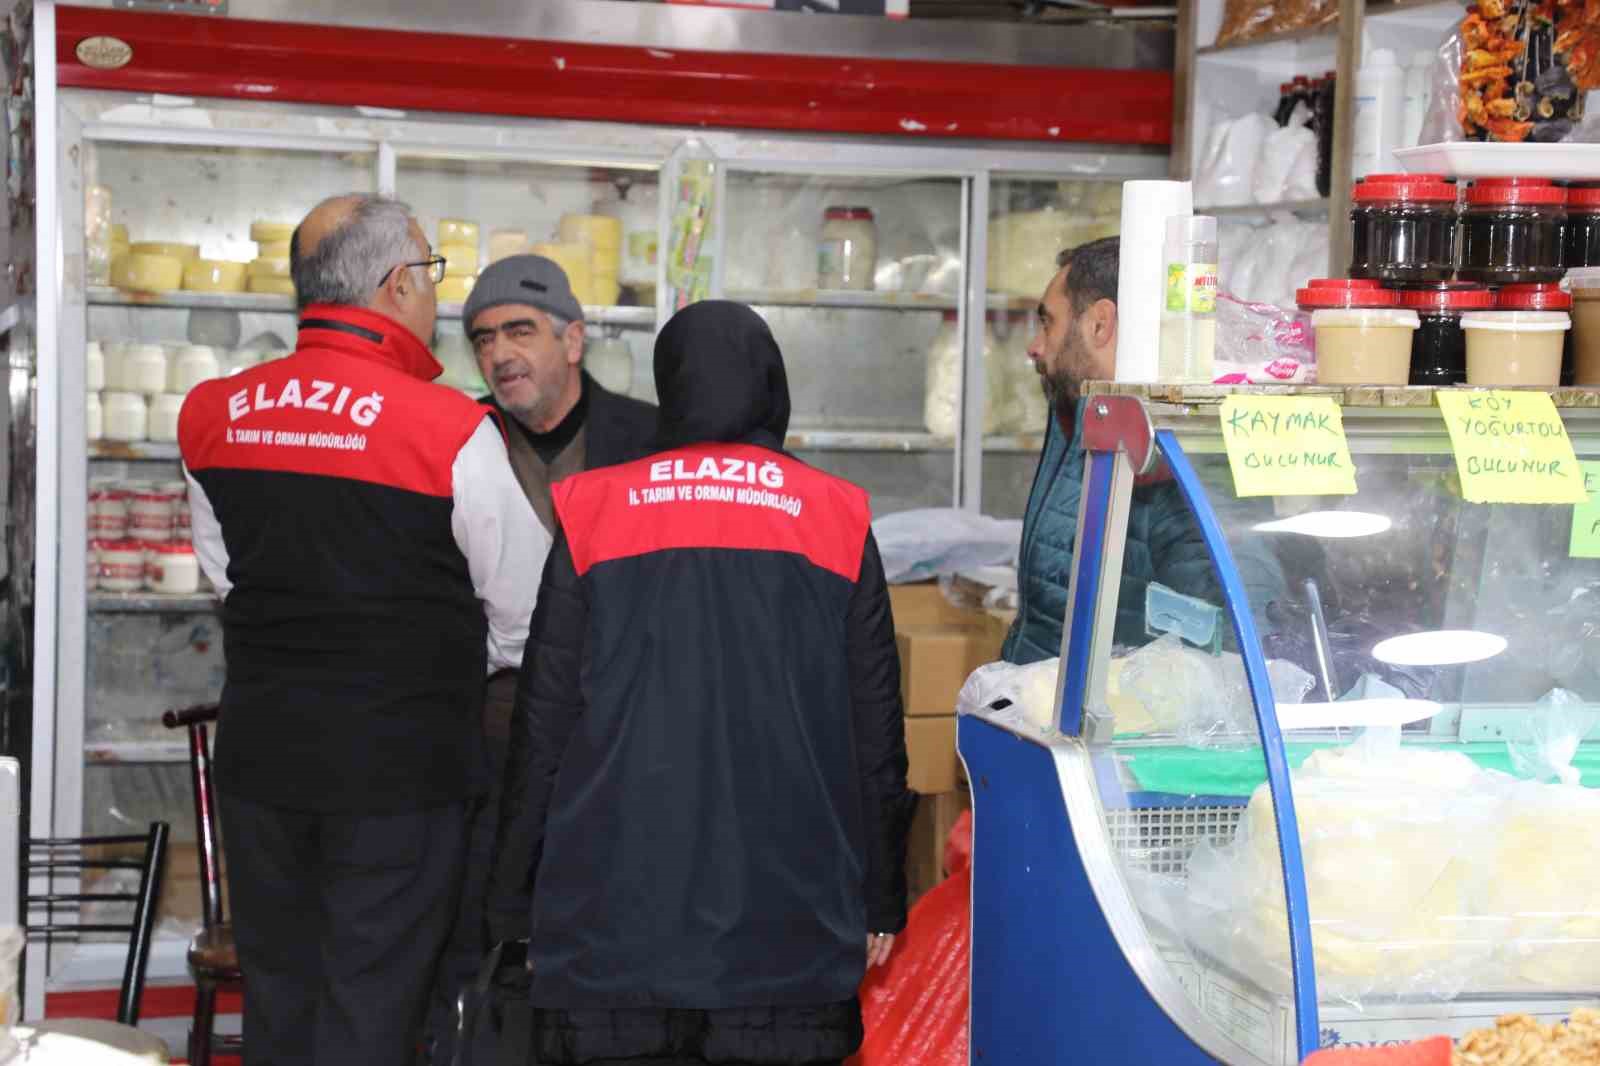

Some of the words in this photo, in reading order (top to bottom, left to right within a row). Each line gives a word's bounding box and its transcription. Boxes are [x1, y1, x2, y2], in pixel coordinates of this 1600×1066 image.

[228, 378, 385, 428] ELAZIĞ
[1227, 408, 1340, 438] KAYMAK
[236, 429, 260, 444] TARIM
[262, 430, 274, 445] VE
[275, 431, 308, 447] ORMAN
[308, 432, 367, 451] MÜDÜRLÜĞÜ
[650, 456, 785, 489] ELAZIĞ
[1467, 455, 1569, 478] BULUNUR
[628, 488, 640, 506] İL
[641, 486, 675, 504] TARIM
[677, 485, 692, 501] VE
[695, 485, 735, 502] ORMAN
[736, 487, 803, 518] MÜDÜRLÜĞÜ
